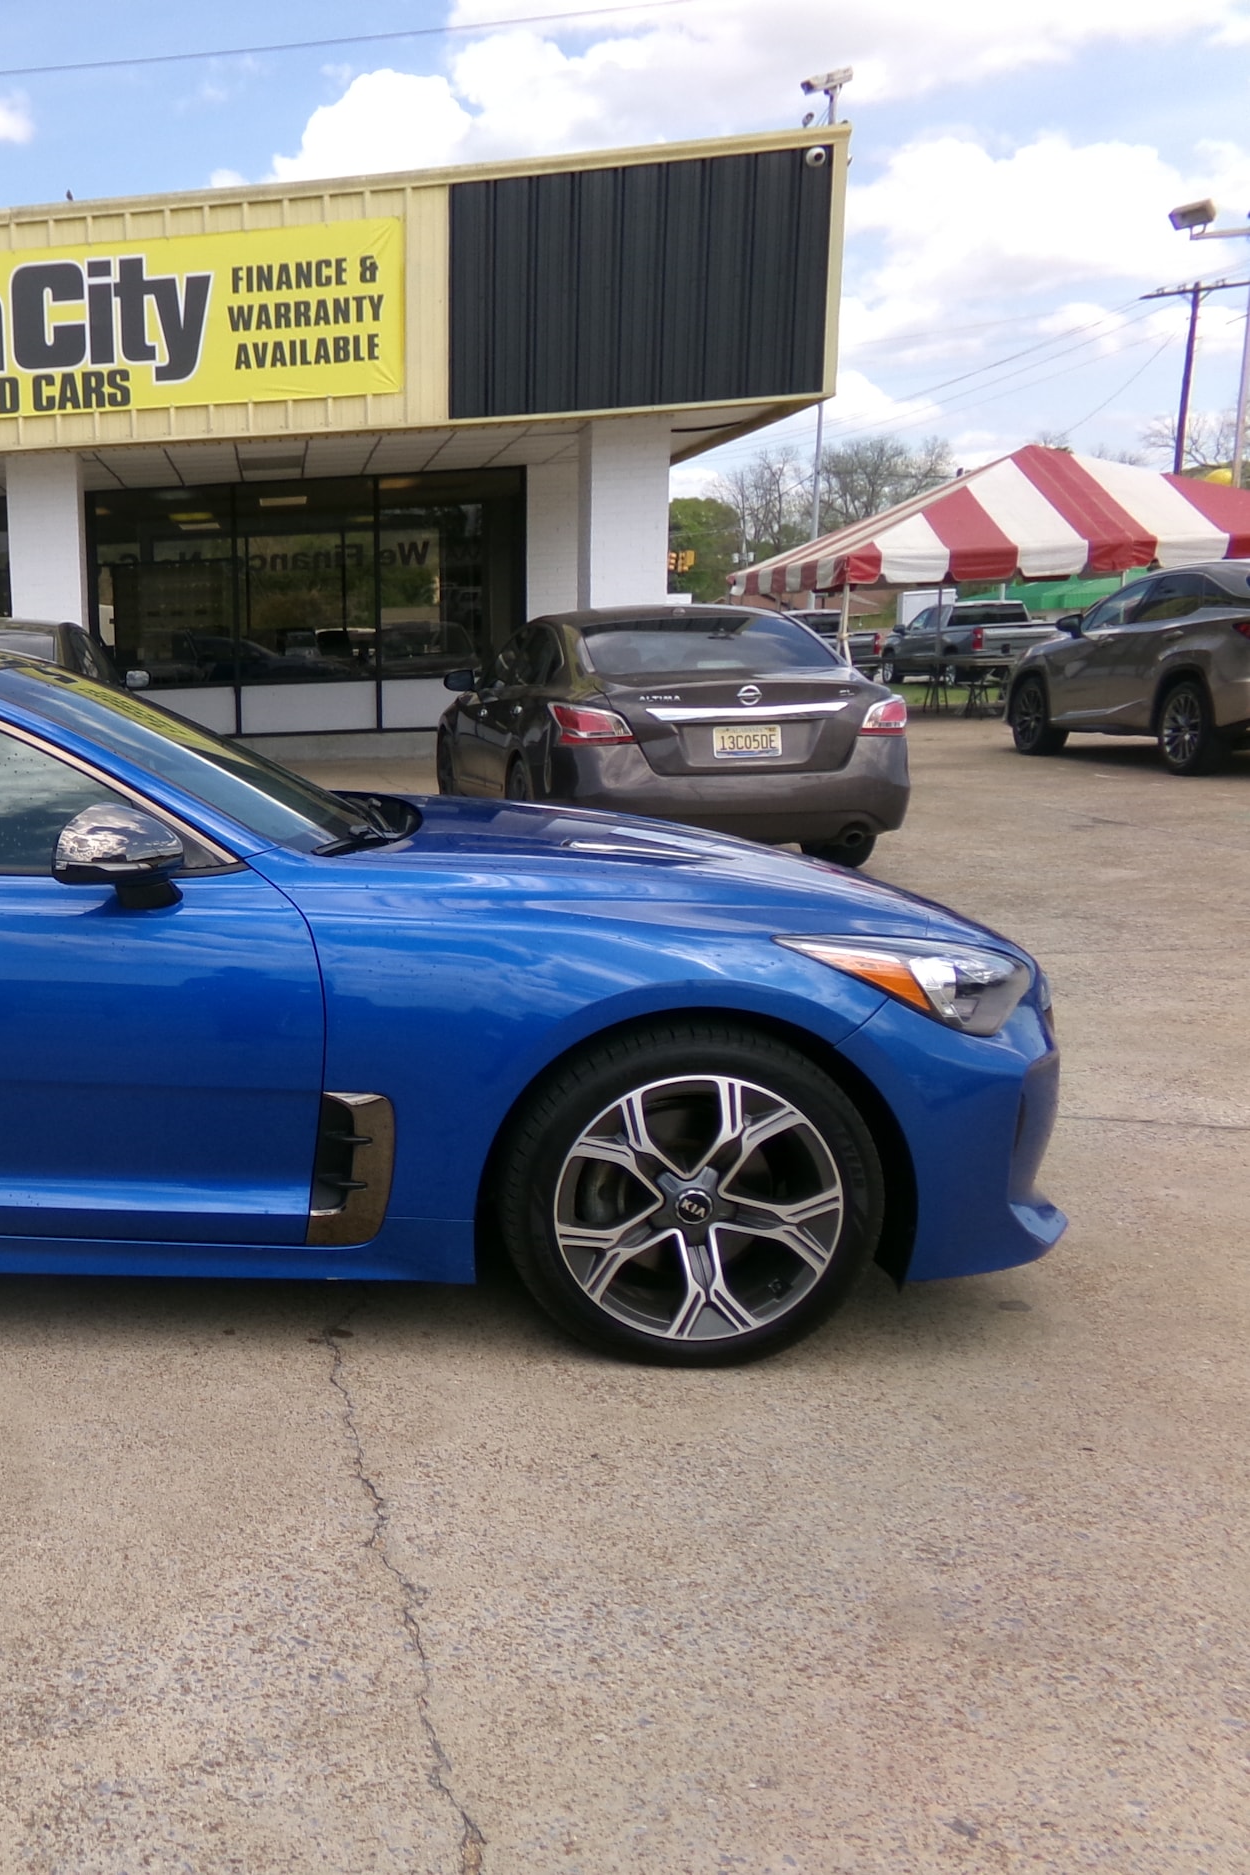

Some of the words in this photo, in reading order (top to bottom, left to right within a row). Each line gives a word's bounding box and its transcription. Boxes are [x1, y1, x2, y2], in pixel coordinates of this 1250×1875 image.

[231, 257, 347, 294] FINANCE
[359, 255, 379, 284] &
[227, 294, 384, 332] WARRANTY
[235, 333, 379, 370] AVAILABLE
[32, 368, 131, 412] CARS
[639, 694, 682, 702] ALTIMA
[720, 734, 777, 751] 13C05DE
[681, 1198, 706, 1218] KIA
